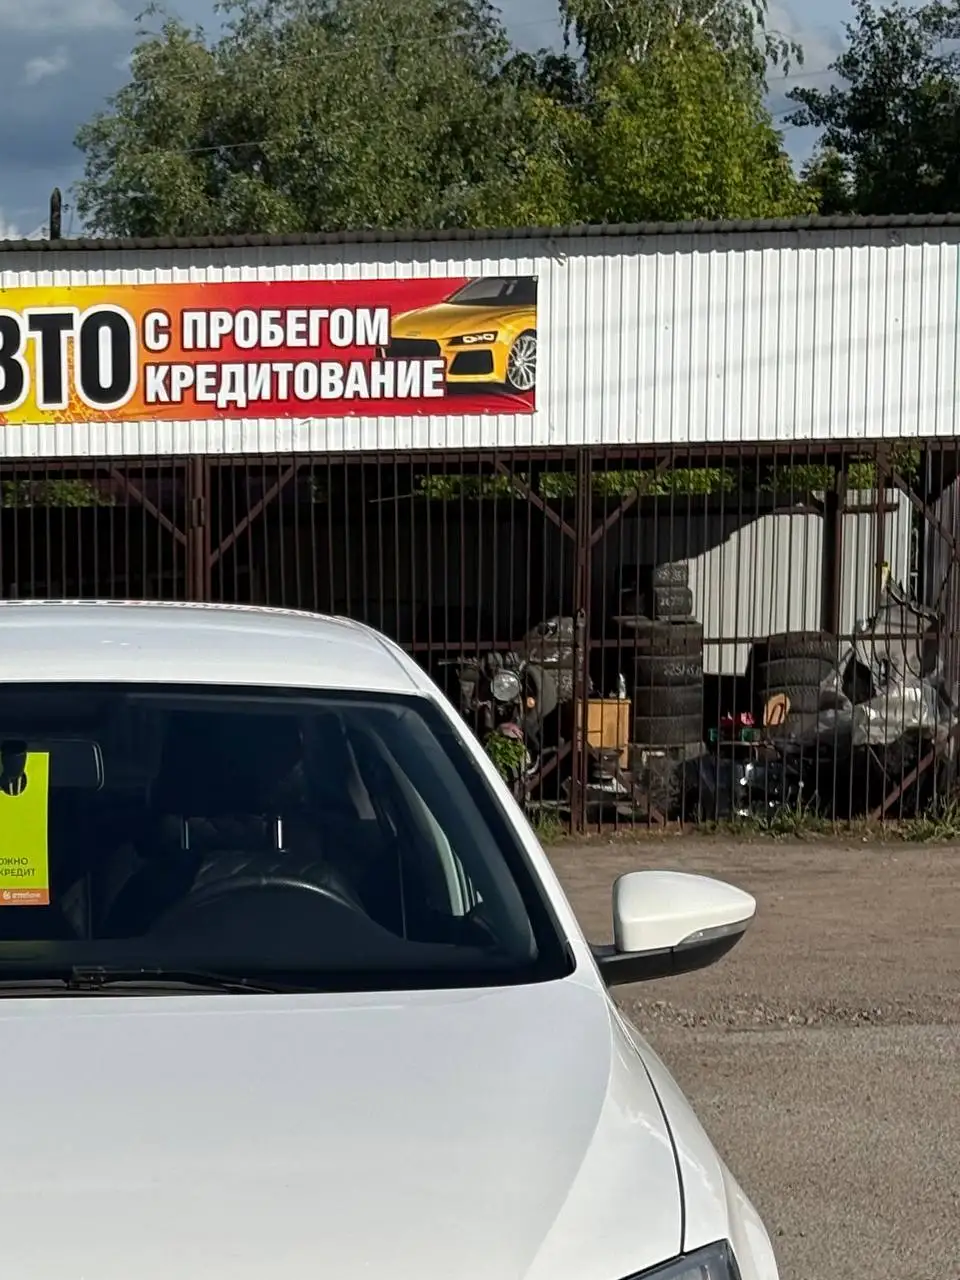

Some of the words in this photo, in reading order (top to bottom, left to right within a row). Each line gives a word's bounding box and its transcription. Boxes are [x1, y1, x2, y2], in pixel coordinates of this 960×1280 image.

[144, 312, 169, 351] С
[182, 308, 389, 349] ПРОБЕГОМ
[145, 360, 445, 409] КРЕДИТОВАНИЕ
